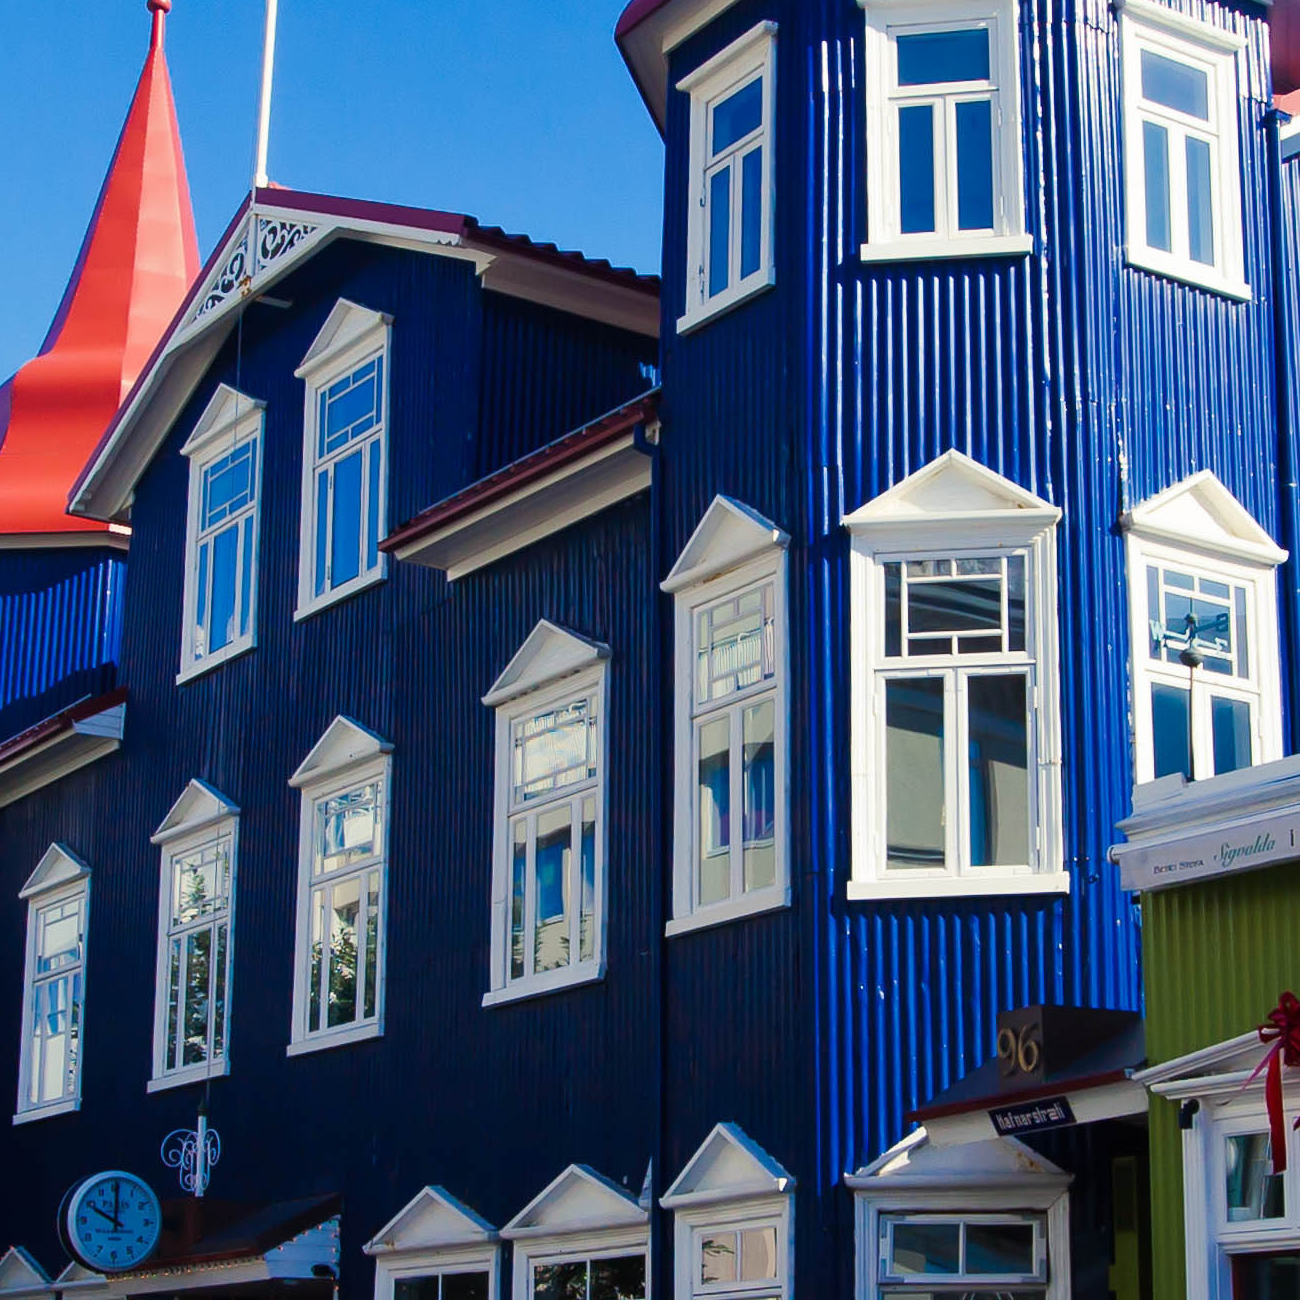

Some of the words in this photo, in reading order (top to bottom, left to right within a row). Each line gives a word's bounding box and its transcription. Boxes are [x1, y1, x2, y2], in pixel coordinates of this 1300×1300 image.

[1212, 832, 1276, 868] Sigvalda
[997, 1021, 1040, 1077] 96
[102, 1200, 130, 1211] PAIS
